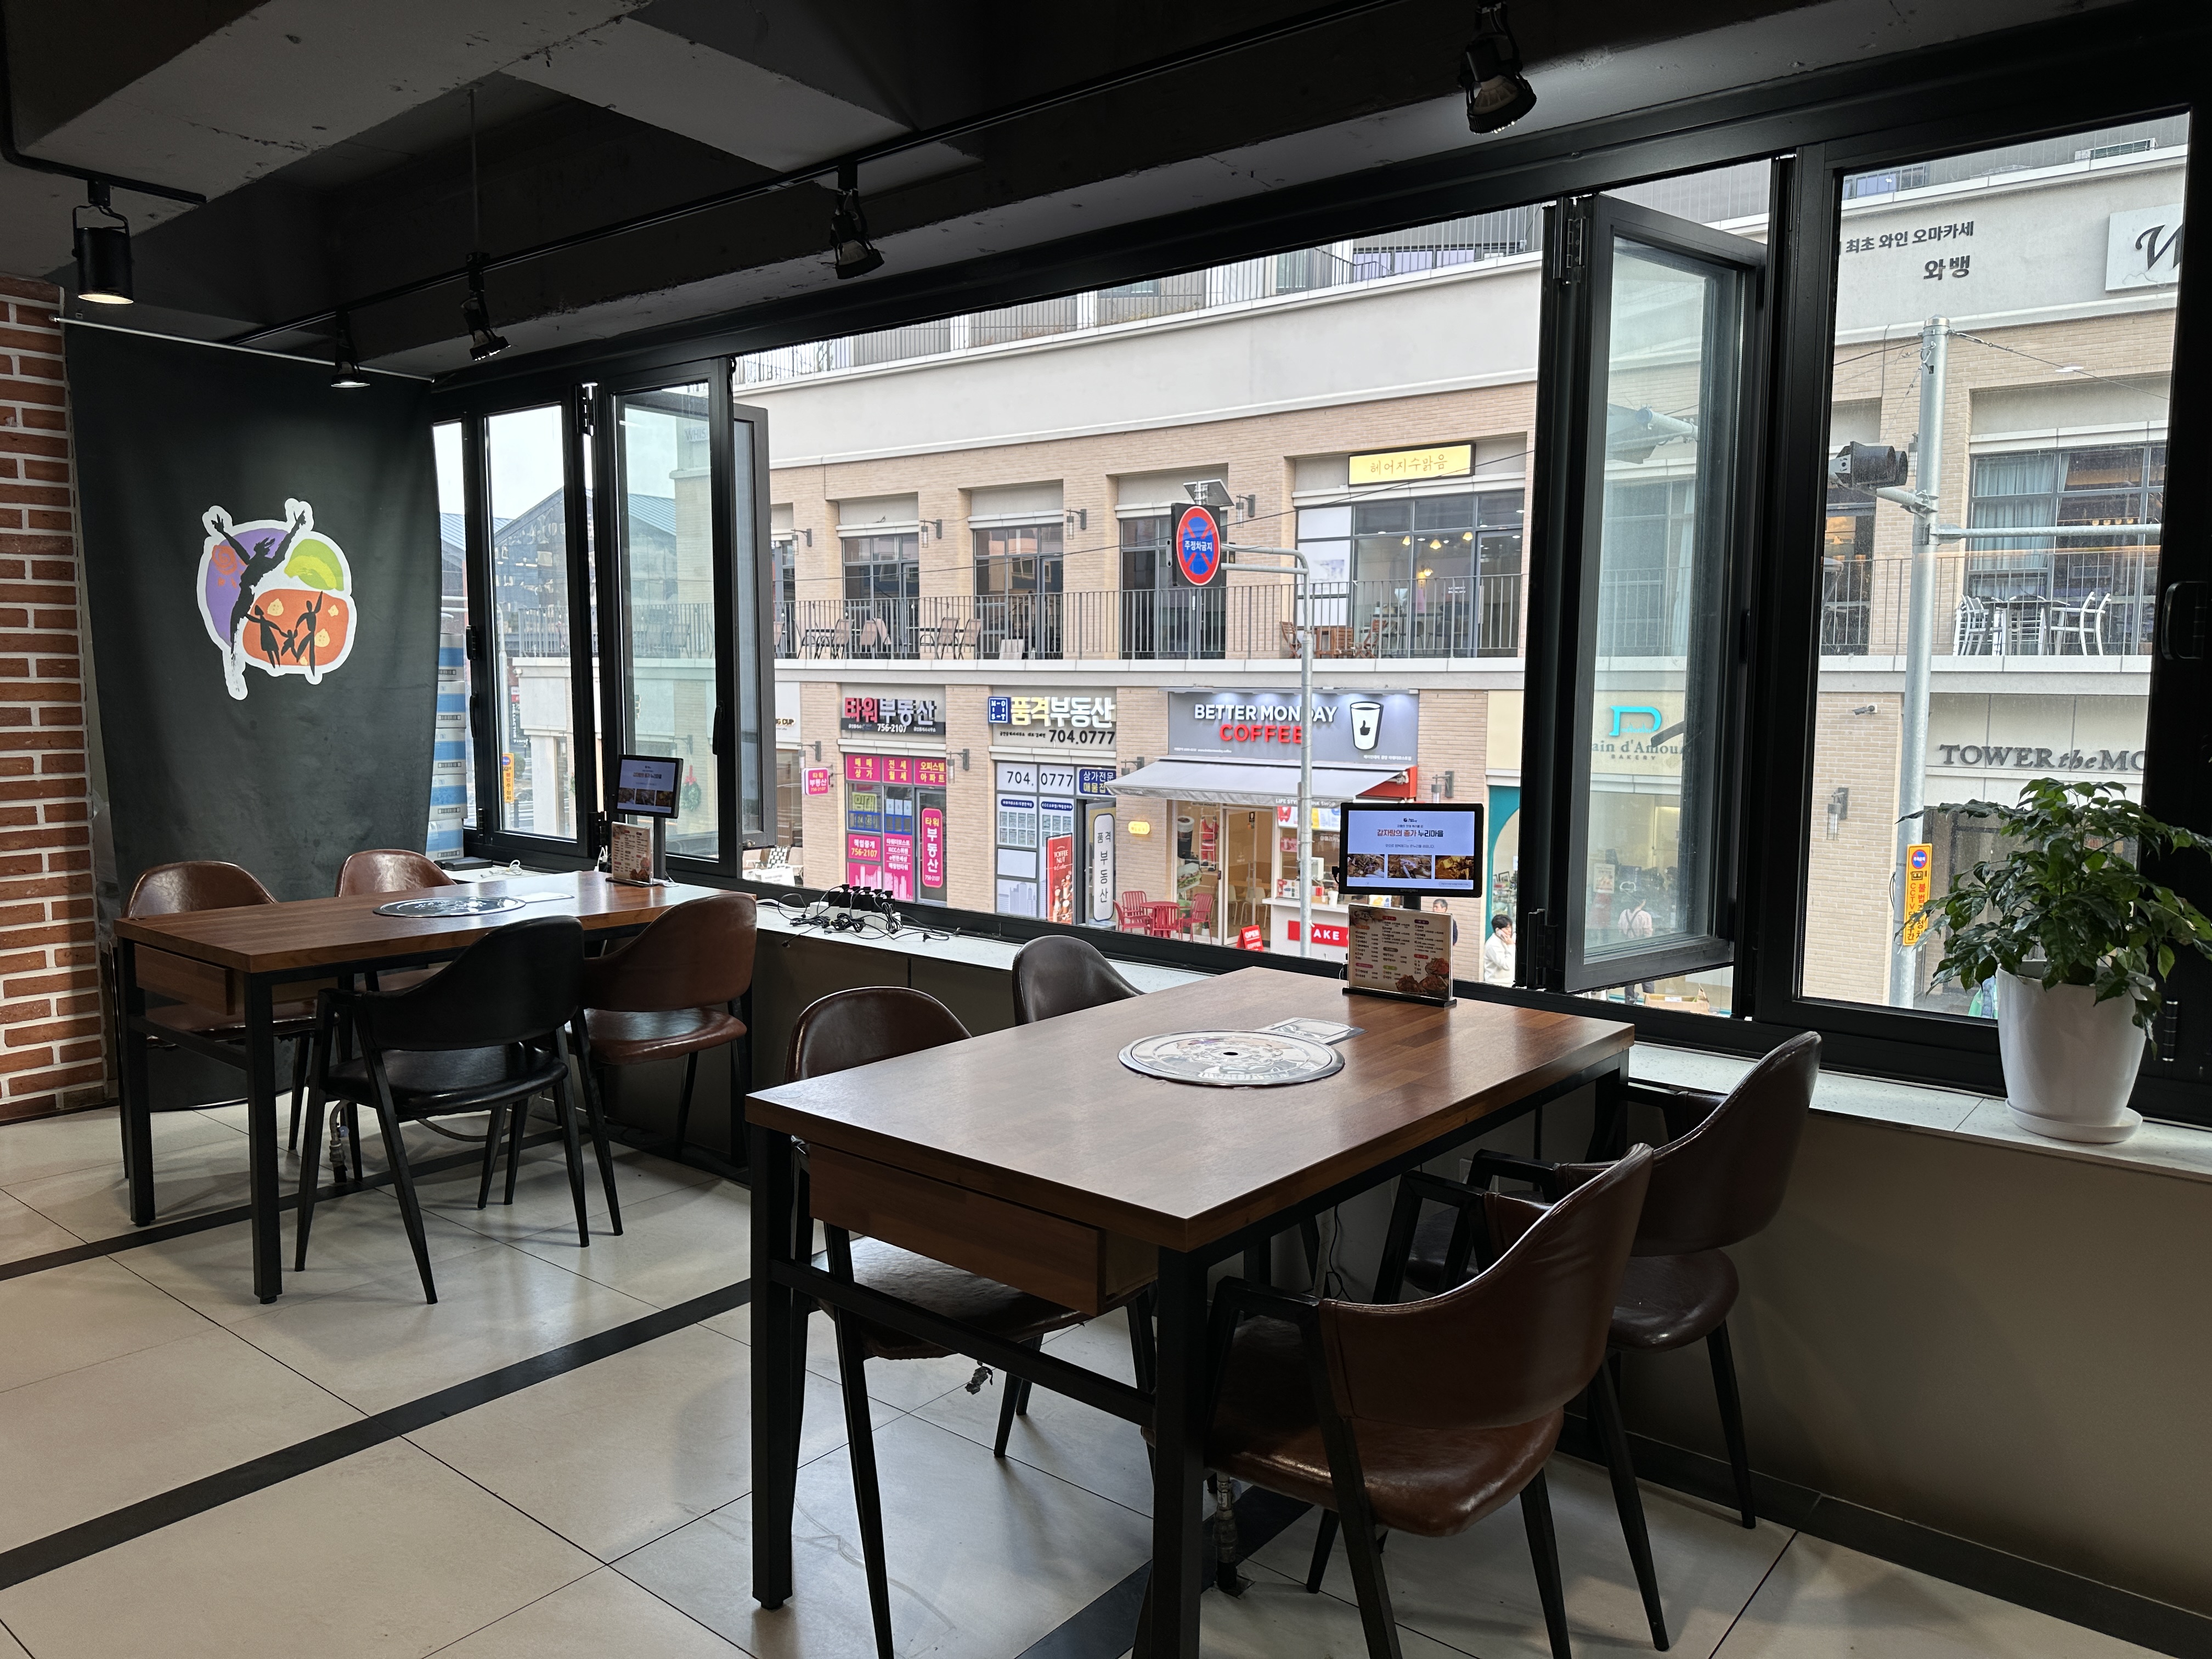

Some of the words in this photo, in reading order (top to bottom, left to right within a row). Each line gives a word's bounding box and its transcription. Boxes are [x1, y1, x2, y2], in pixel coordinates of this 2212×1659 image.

[1846, 238, 1875, 253] 최초
[1879, 231, 1908, 249] 와인
[1912, 221, 1974, 244] 오마카세
[684, 428, 708, 441] WHIS
[1184, 540, 1213, 552] 주정차금지
[845, 697, 935, 726] 타워부동산
[1011, 697, 1113, 728] 품격부동산
[1194, 704, 1256, 721] BETTER
[1261, 706, 1338, 723] MONAY
[877, 723, 907, 733] 756-2107
[1219, 724, 1302, 743] COFFEE
[1048, 730, 1115, 745] 704.0777
[1591, 741, 1615, 752] ain
[1939, 744, 2055, 768] TOWER
[854, 758, 873, 768] 매매
[888, 759, 907, 770] 전세
[920, 761, 945, 772] 오피스텔
[855, 769, 873, 779] 상가
[888, 770, 907, 781] 월세
[920, 774, 945, 783] 아파트
[1083, 771, 1114, 782] 상가전문
[809, 778, 827, 787] 부동산
[1041, 773, 1073, 788] 0777
[1083, 782, 1107, 794] 매물접
[854, 794, 876, 811] 임대
[924, 817, 939, 827] 타워
[851, 848, 878, 858] 756-2107
[927, 828, 939, 873] 부동산
[1053, 849, 1069, 858] TOFFEE
[1099, 851, 1109, 903] 부동산
[1918, 883, 1926, 904] 불법
[1244, 929, 1260, 939] OPEN
[1313, 928, 1340, 941] AKE
